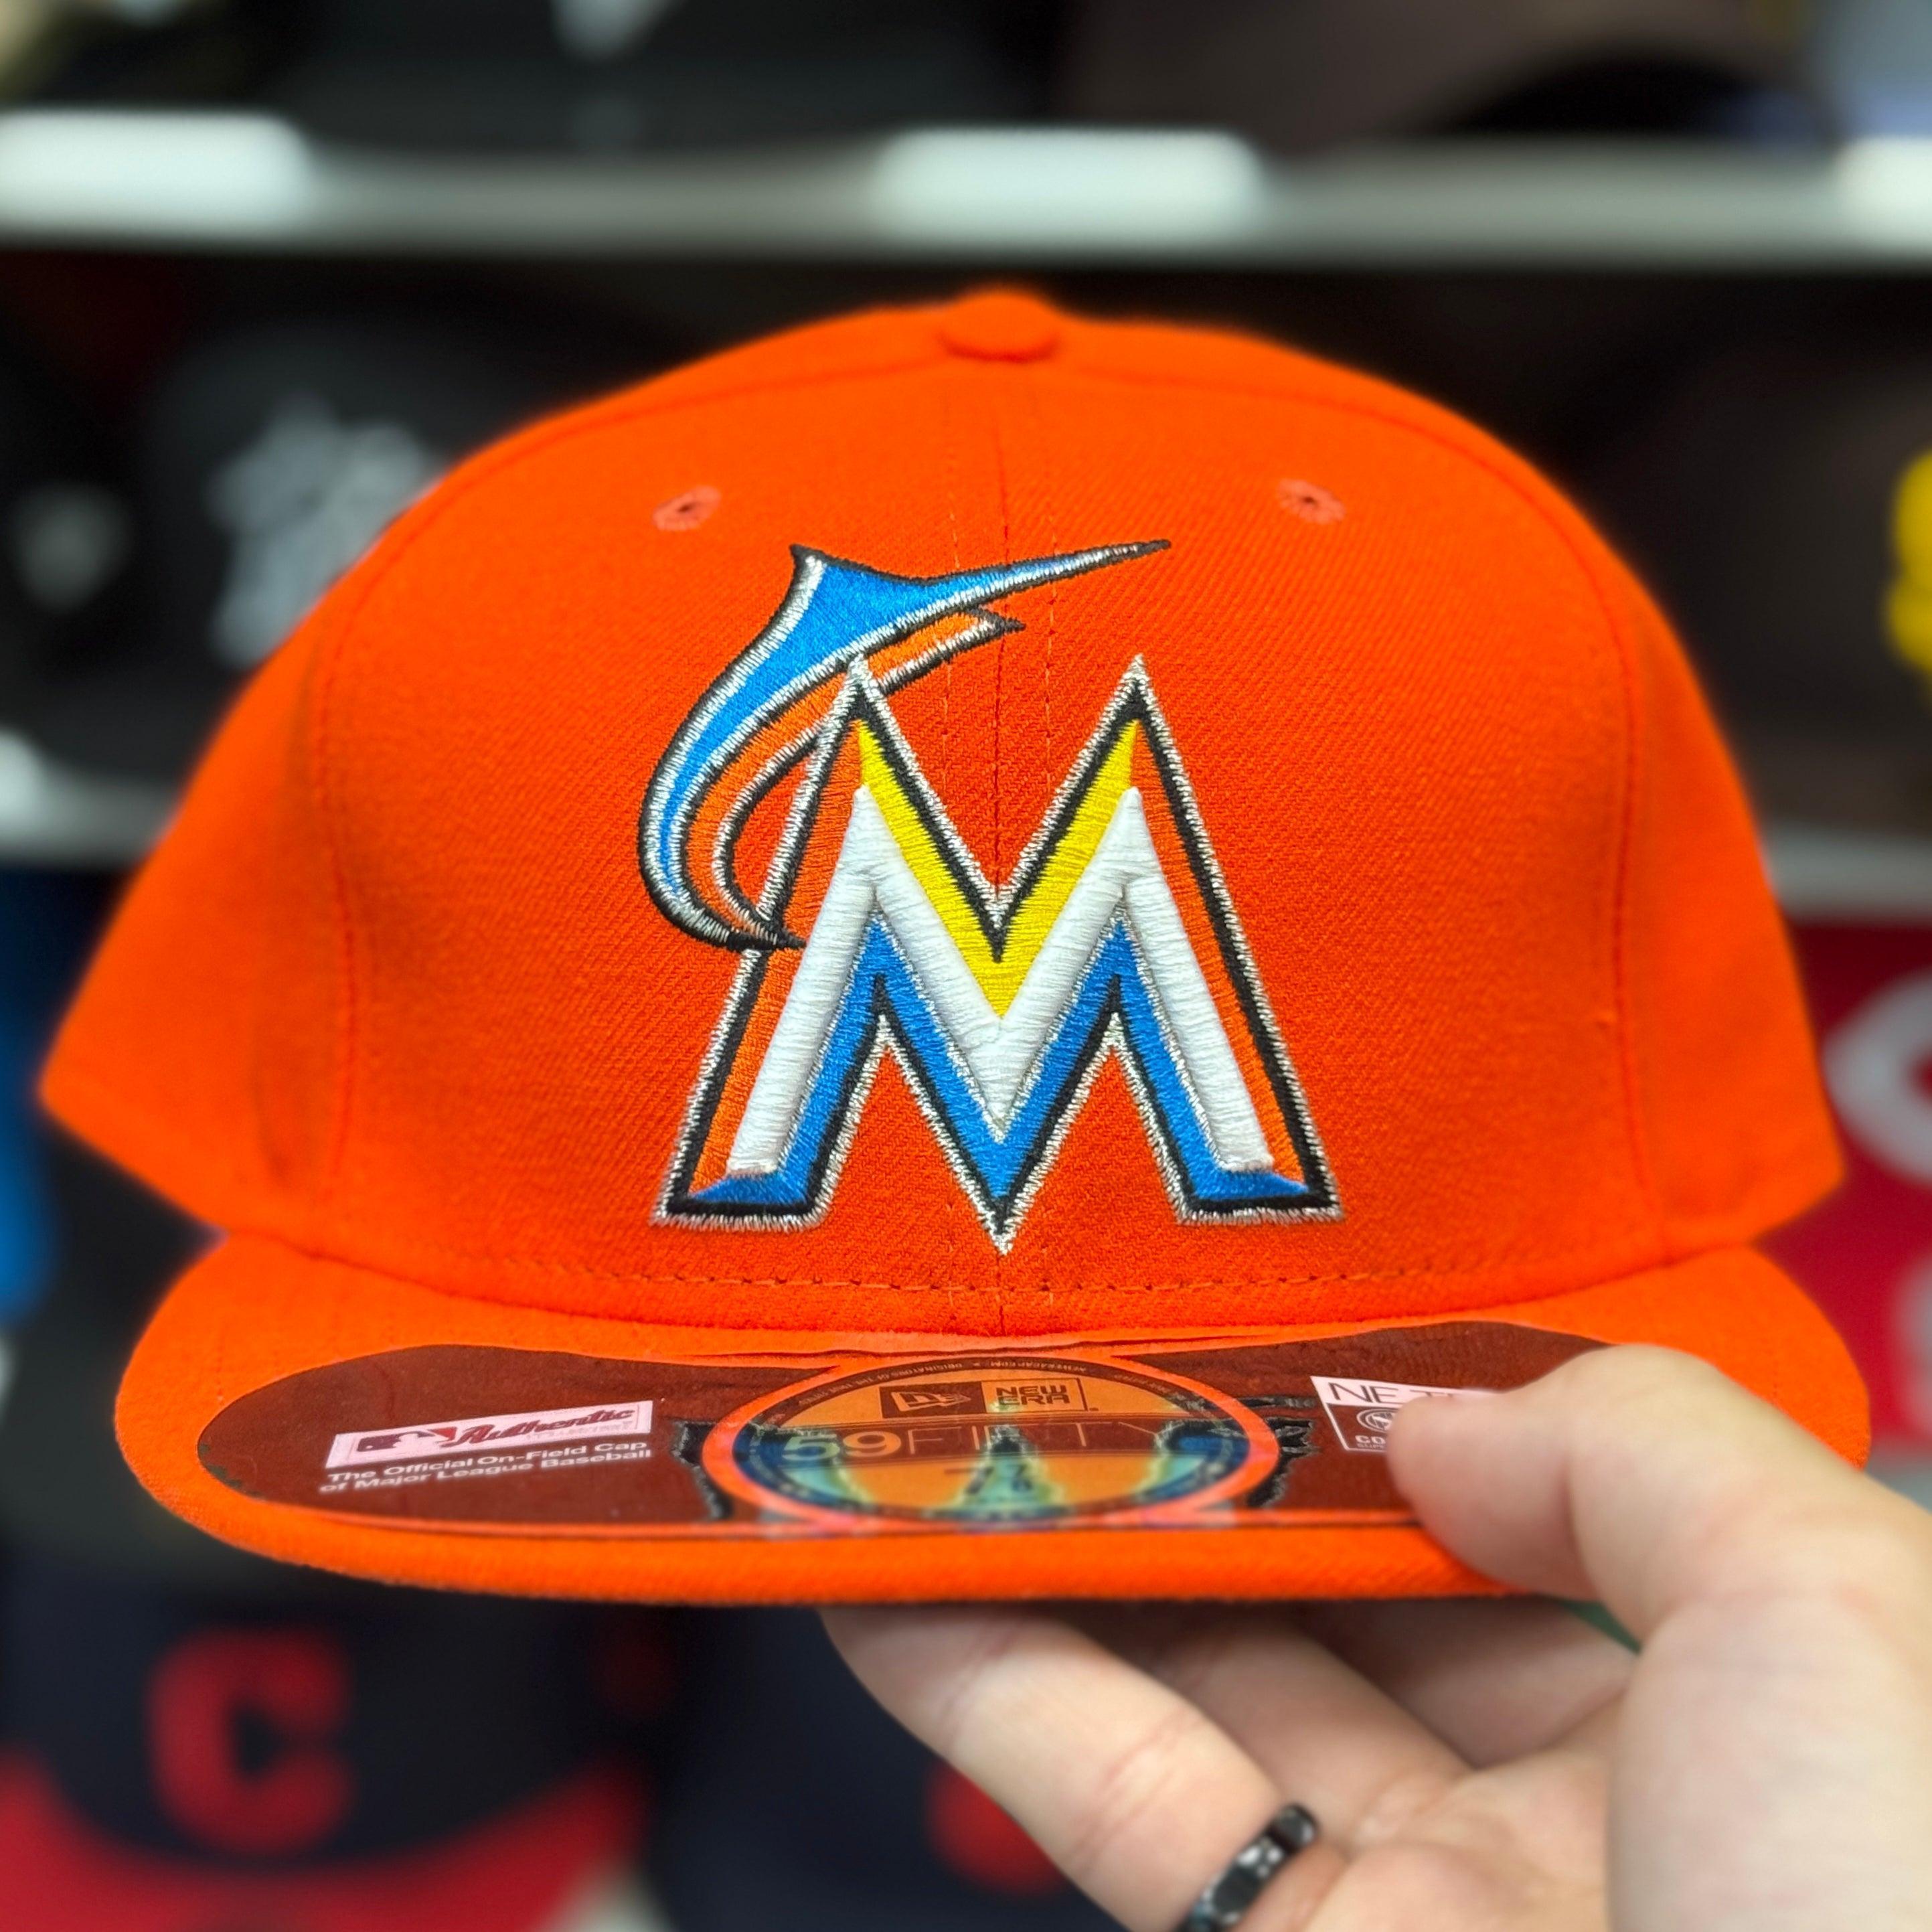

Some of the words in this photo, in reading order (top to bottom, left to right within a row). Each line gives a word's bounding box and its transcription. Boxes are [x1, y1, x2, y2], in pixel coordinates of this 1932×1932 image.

[651, 652, 1344, 1256] M
[995, 1384, 1067, 1397] NEW
[997, 1394, 1070, 1406] ERA
[440, 1409, 635, 1448] Authentic
[319, 1481, 347, 1493] of
[354, 1473, 432, 1489] Major
[436, 1463, 534, 1481] League
[541, 1449, 651, 1468] Baseball
[327, 1471, 377, 1483] The
[384, 1457, 473, 1475] Official
[477, 1445, 587, 1465] On-Field
[594, 1441, 647, 1453] Cap
